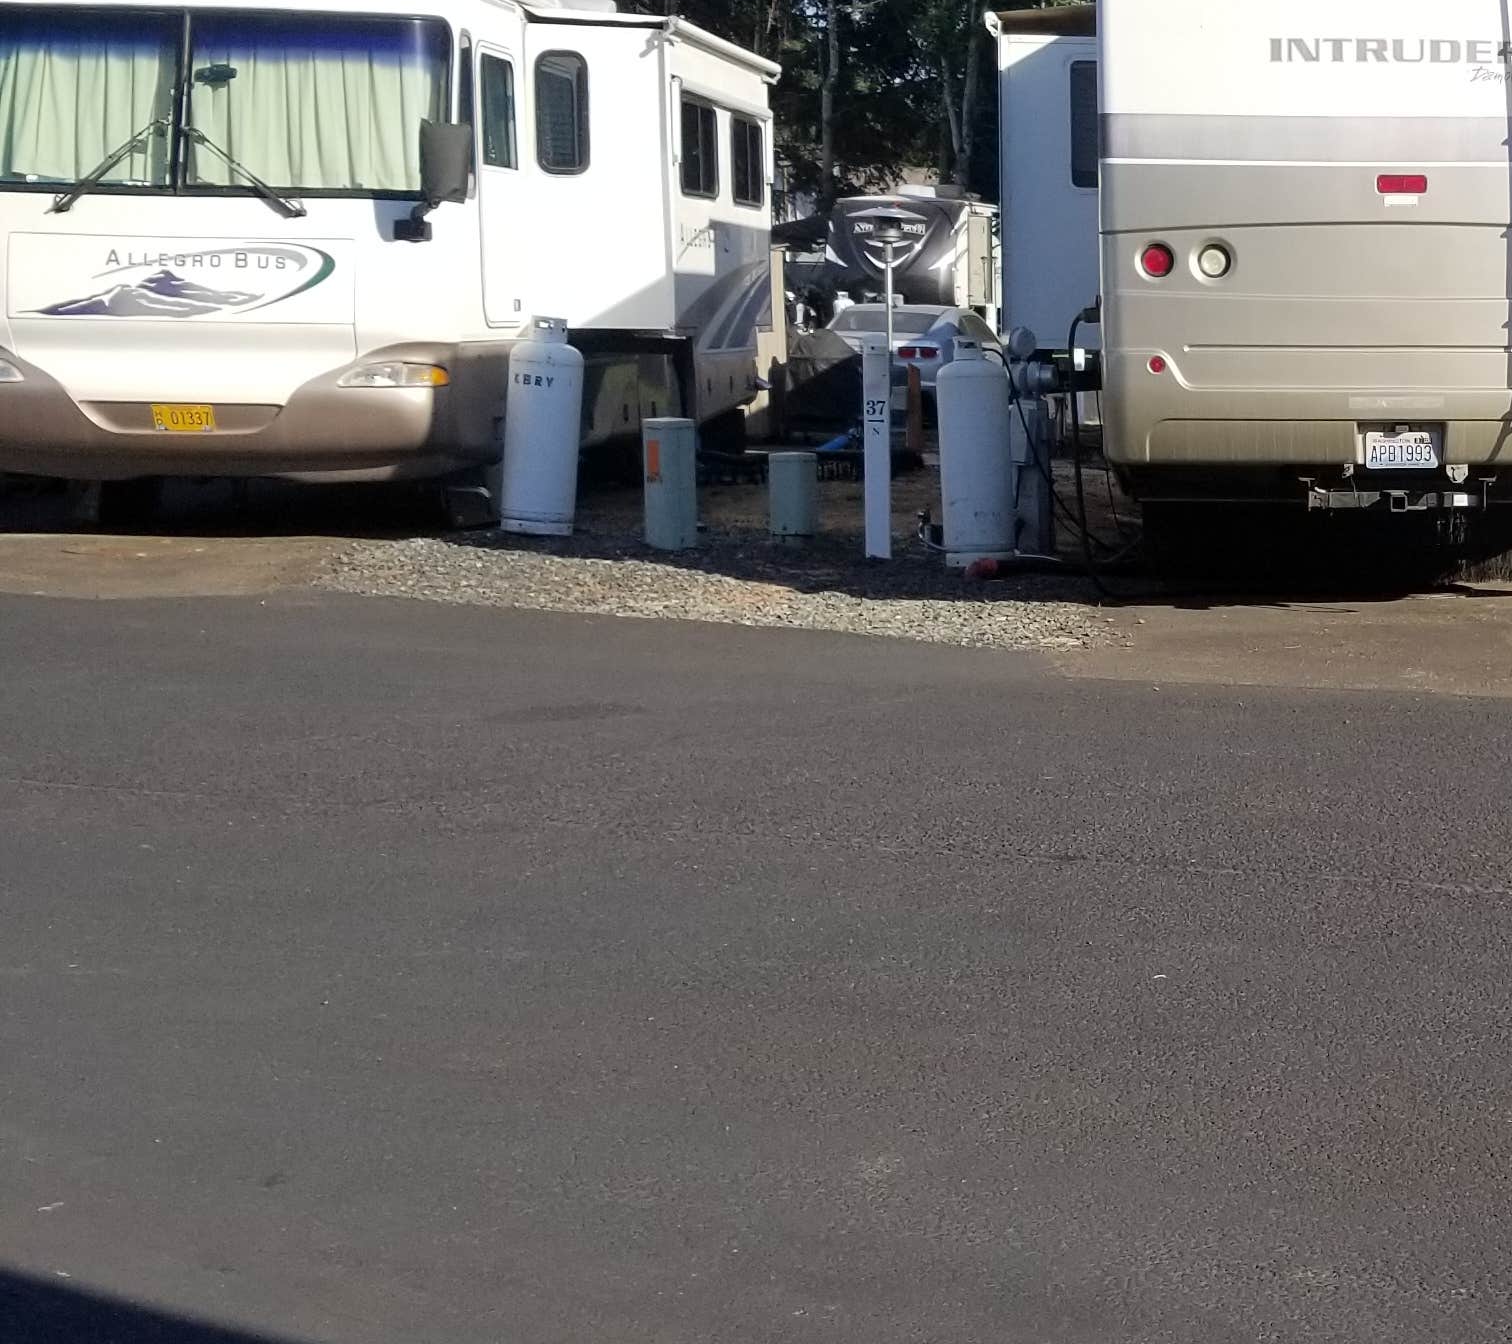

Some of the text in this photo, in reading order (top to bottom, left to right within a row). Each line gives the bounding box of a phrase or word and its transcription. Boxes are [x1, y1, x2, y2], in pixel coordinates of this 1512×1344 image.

[105, 248, 287, 269] ALLEGRO BUS
[866, 400, 886, 416] 37
[170, 410, 209, 425] 01337
[1370, 445, 1432, 462] APB1993
